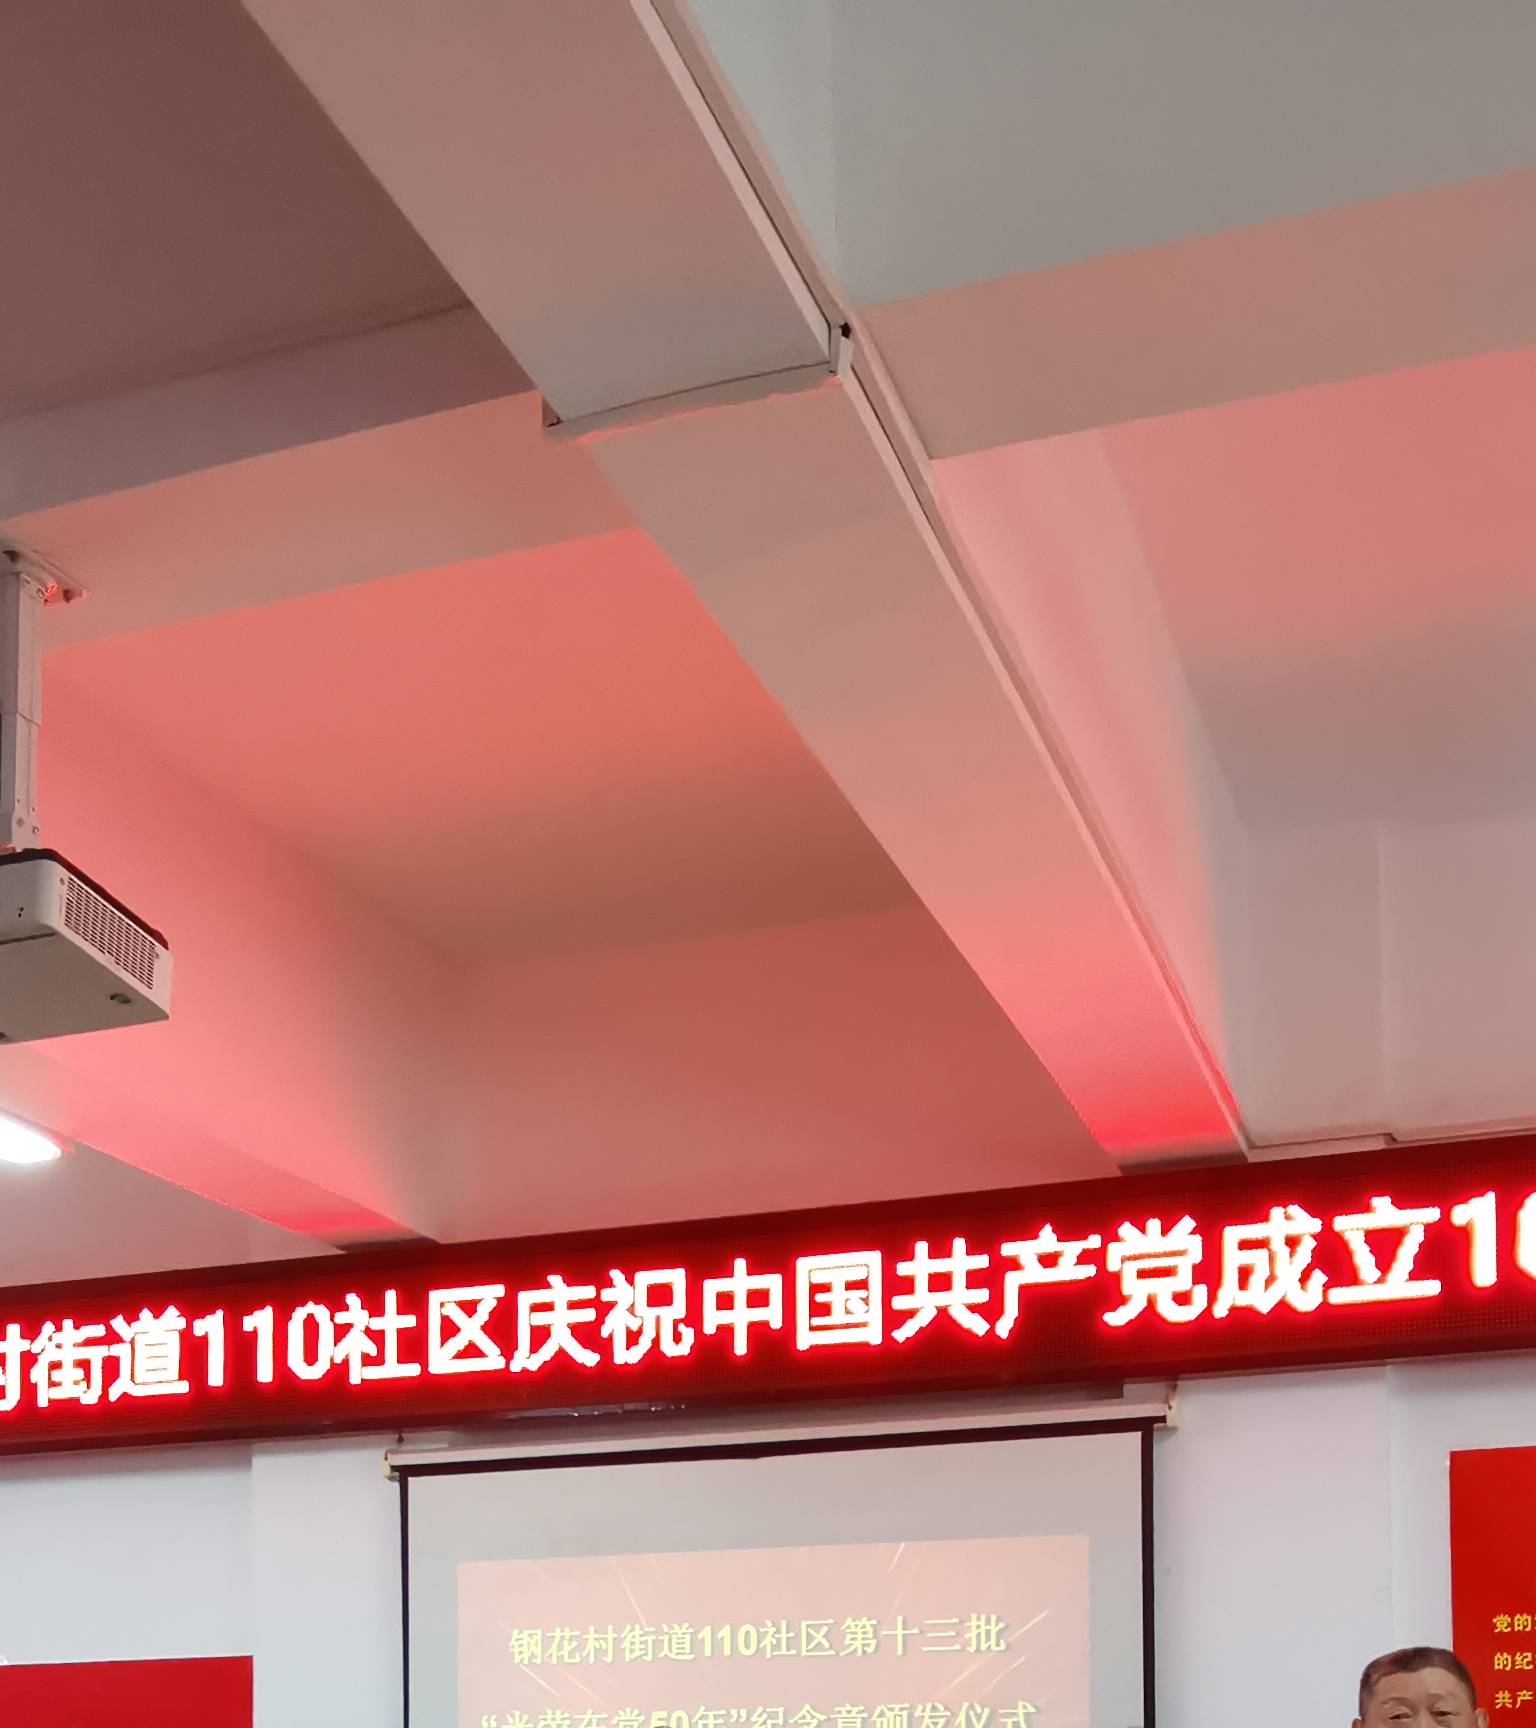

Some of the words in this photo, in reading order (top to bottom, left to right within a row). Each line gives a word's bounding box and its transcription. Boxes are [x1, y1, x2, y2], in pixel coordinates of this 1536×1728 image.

[510, 1613, 1007, 1666] 钢花村街道110社区第十三批
